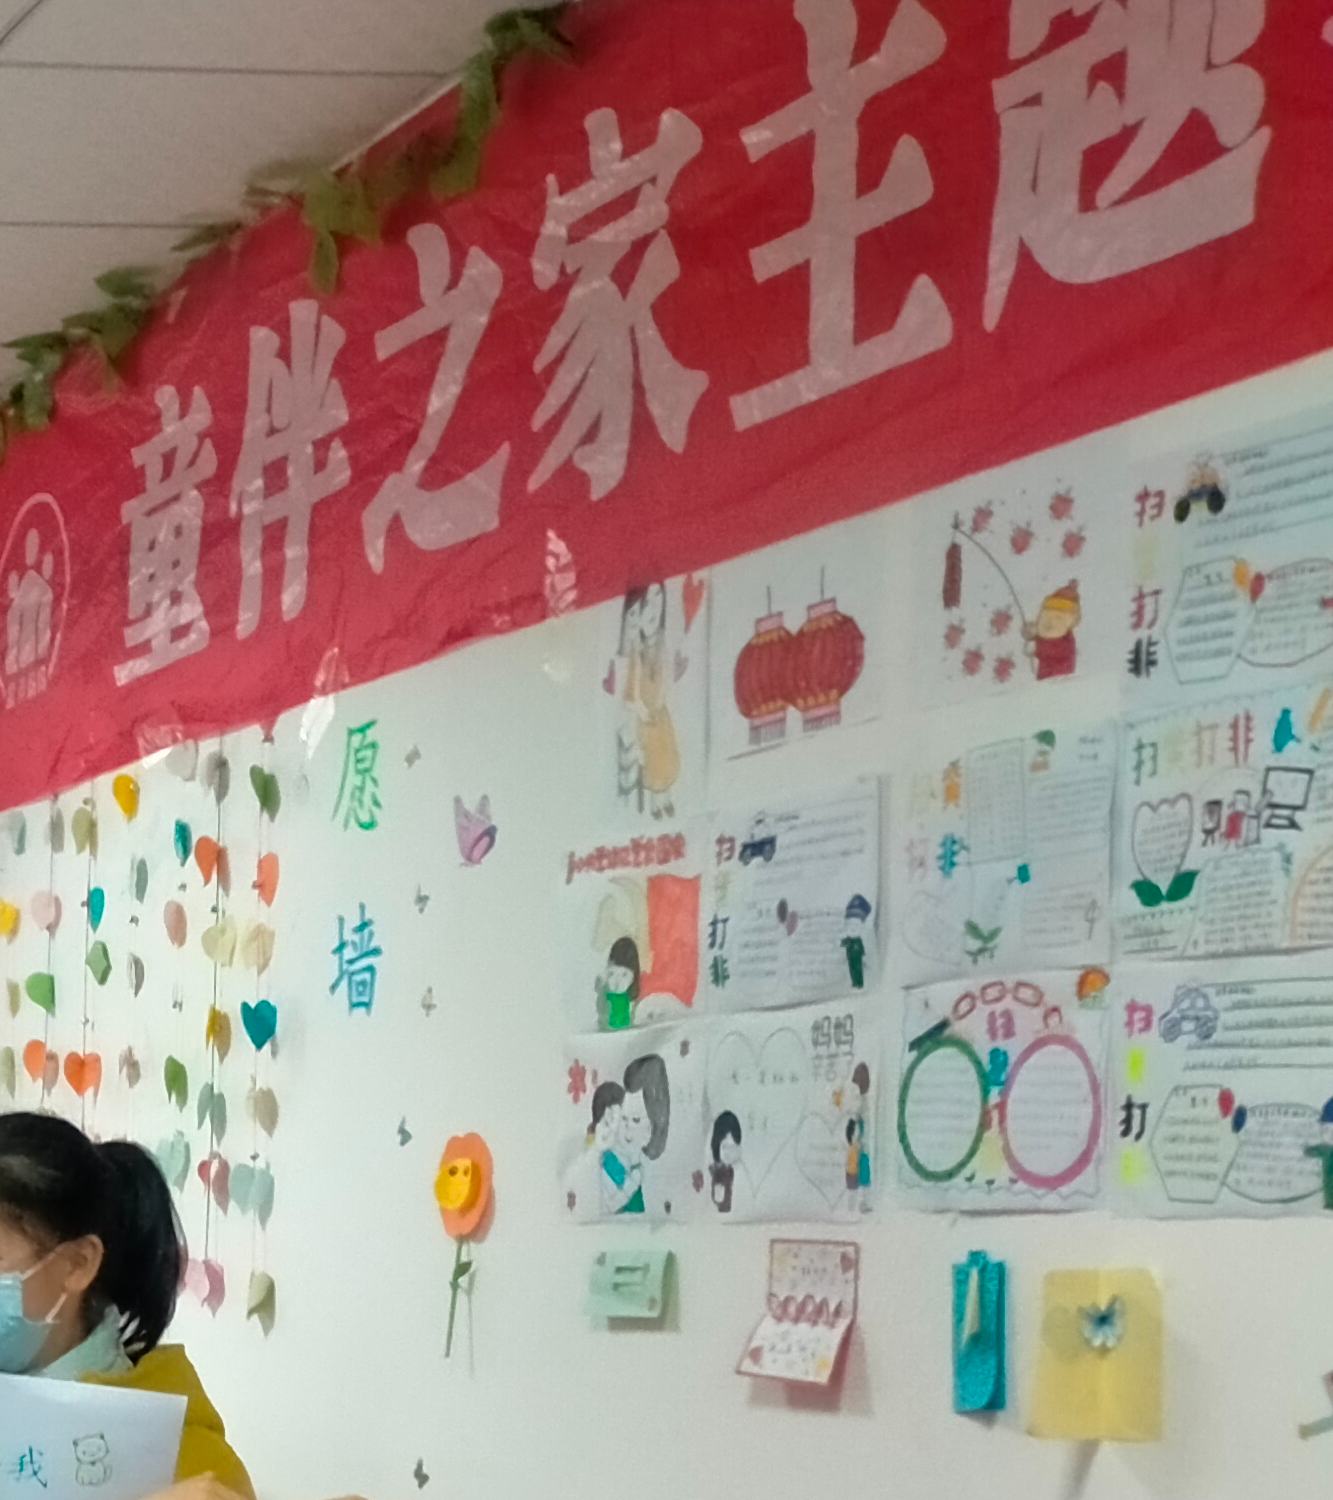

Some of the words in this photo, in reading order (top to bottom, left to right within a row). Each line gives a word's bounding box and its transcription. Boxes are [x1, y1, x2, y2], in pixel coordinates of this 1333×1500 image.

[114, 0, 1272, 686] 童伴之家主题
